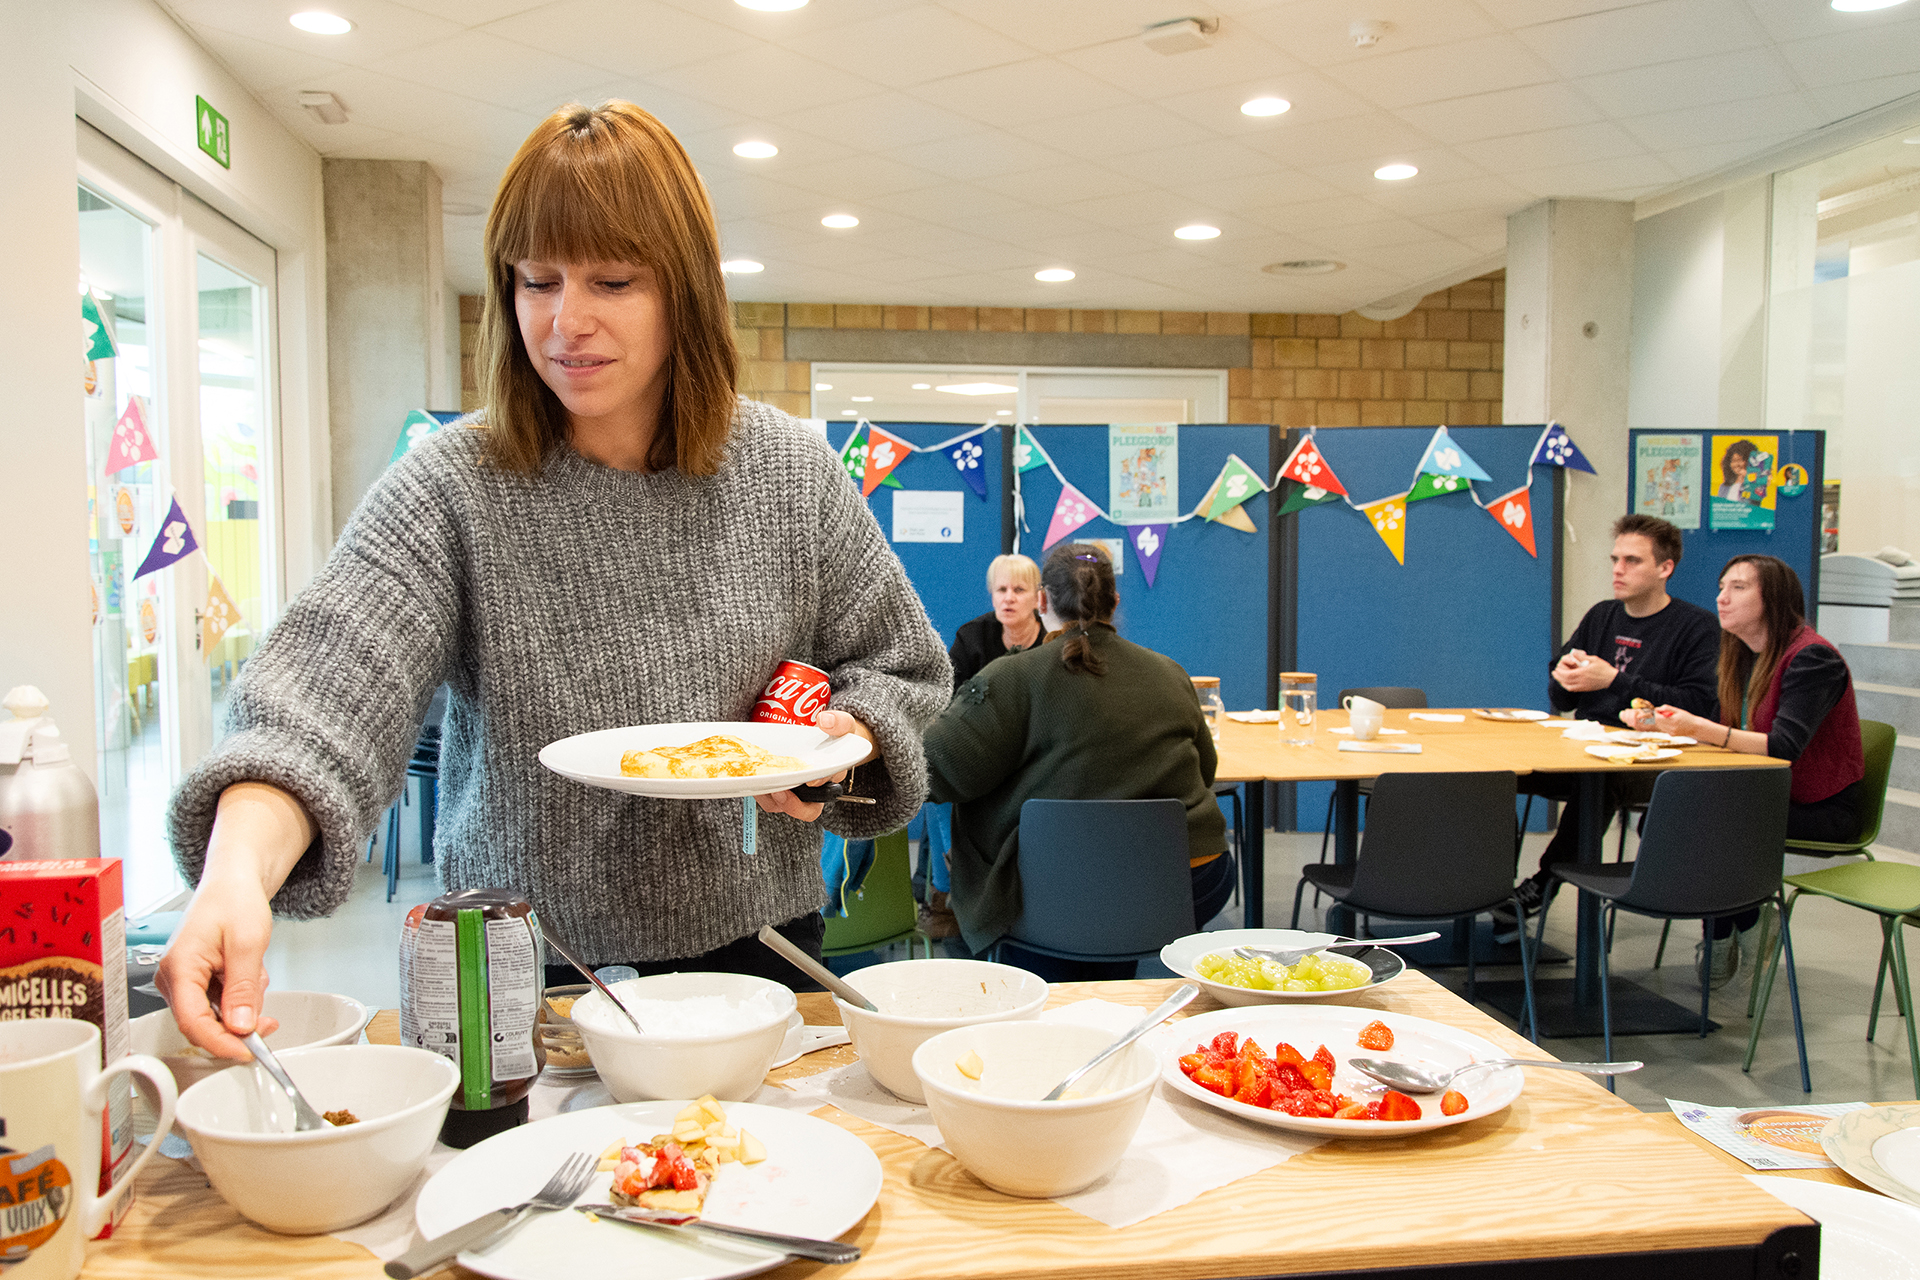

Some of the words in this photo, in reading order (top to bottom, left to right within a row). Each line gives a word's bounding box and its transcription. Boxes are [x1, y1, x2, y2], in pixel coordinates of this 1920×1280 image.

[759, 710, 797, 725] ORIGINAL
[505, 1029, 528, 1038] COLRUYT
[6, 1196, 47, 1233] VOIX
